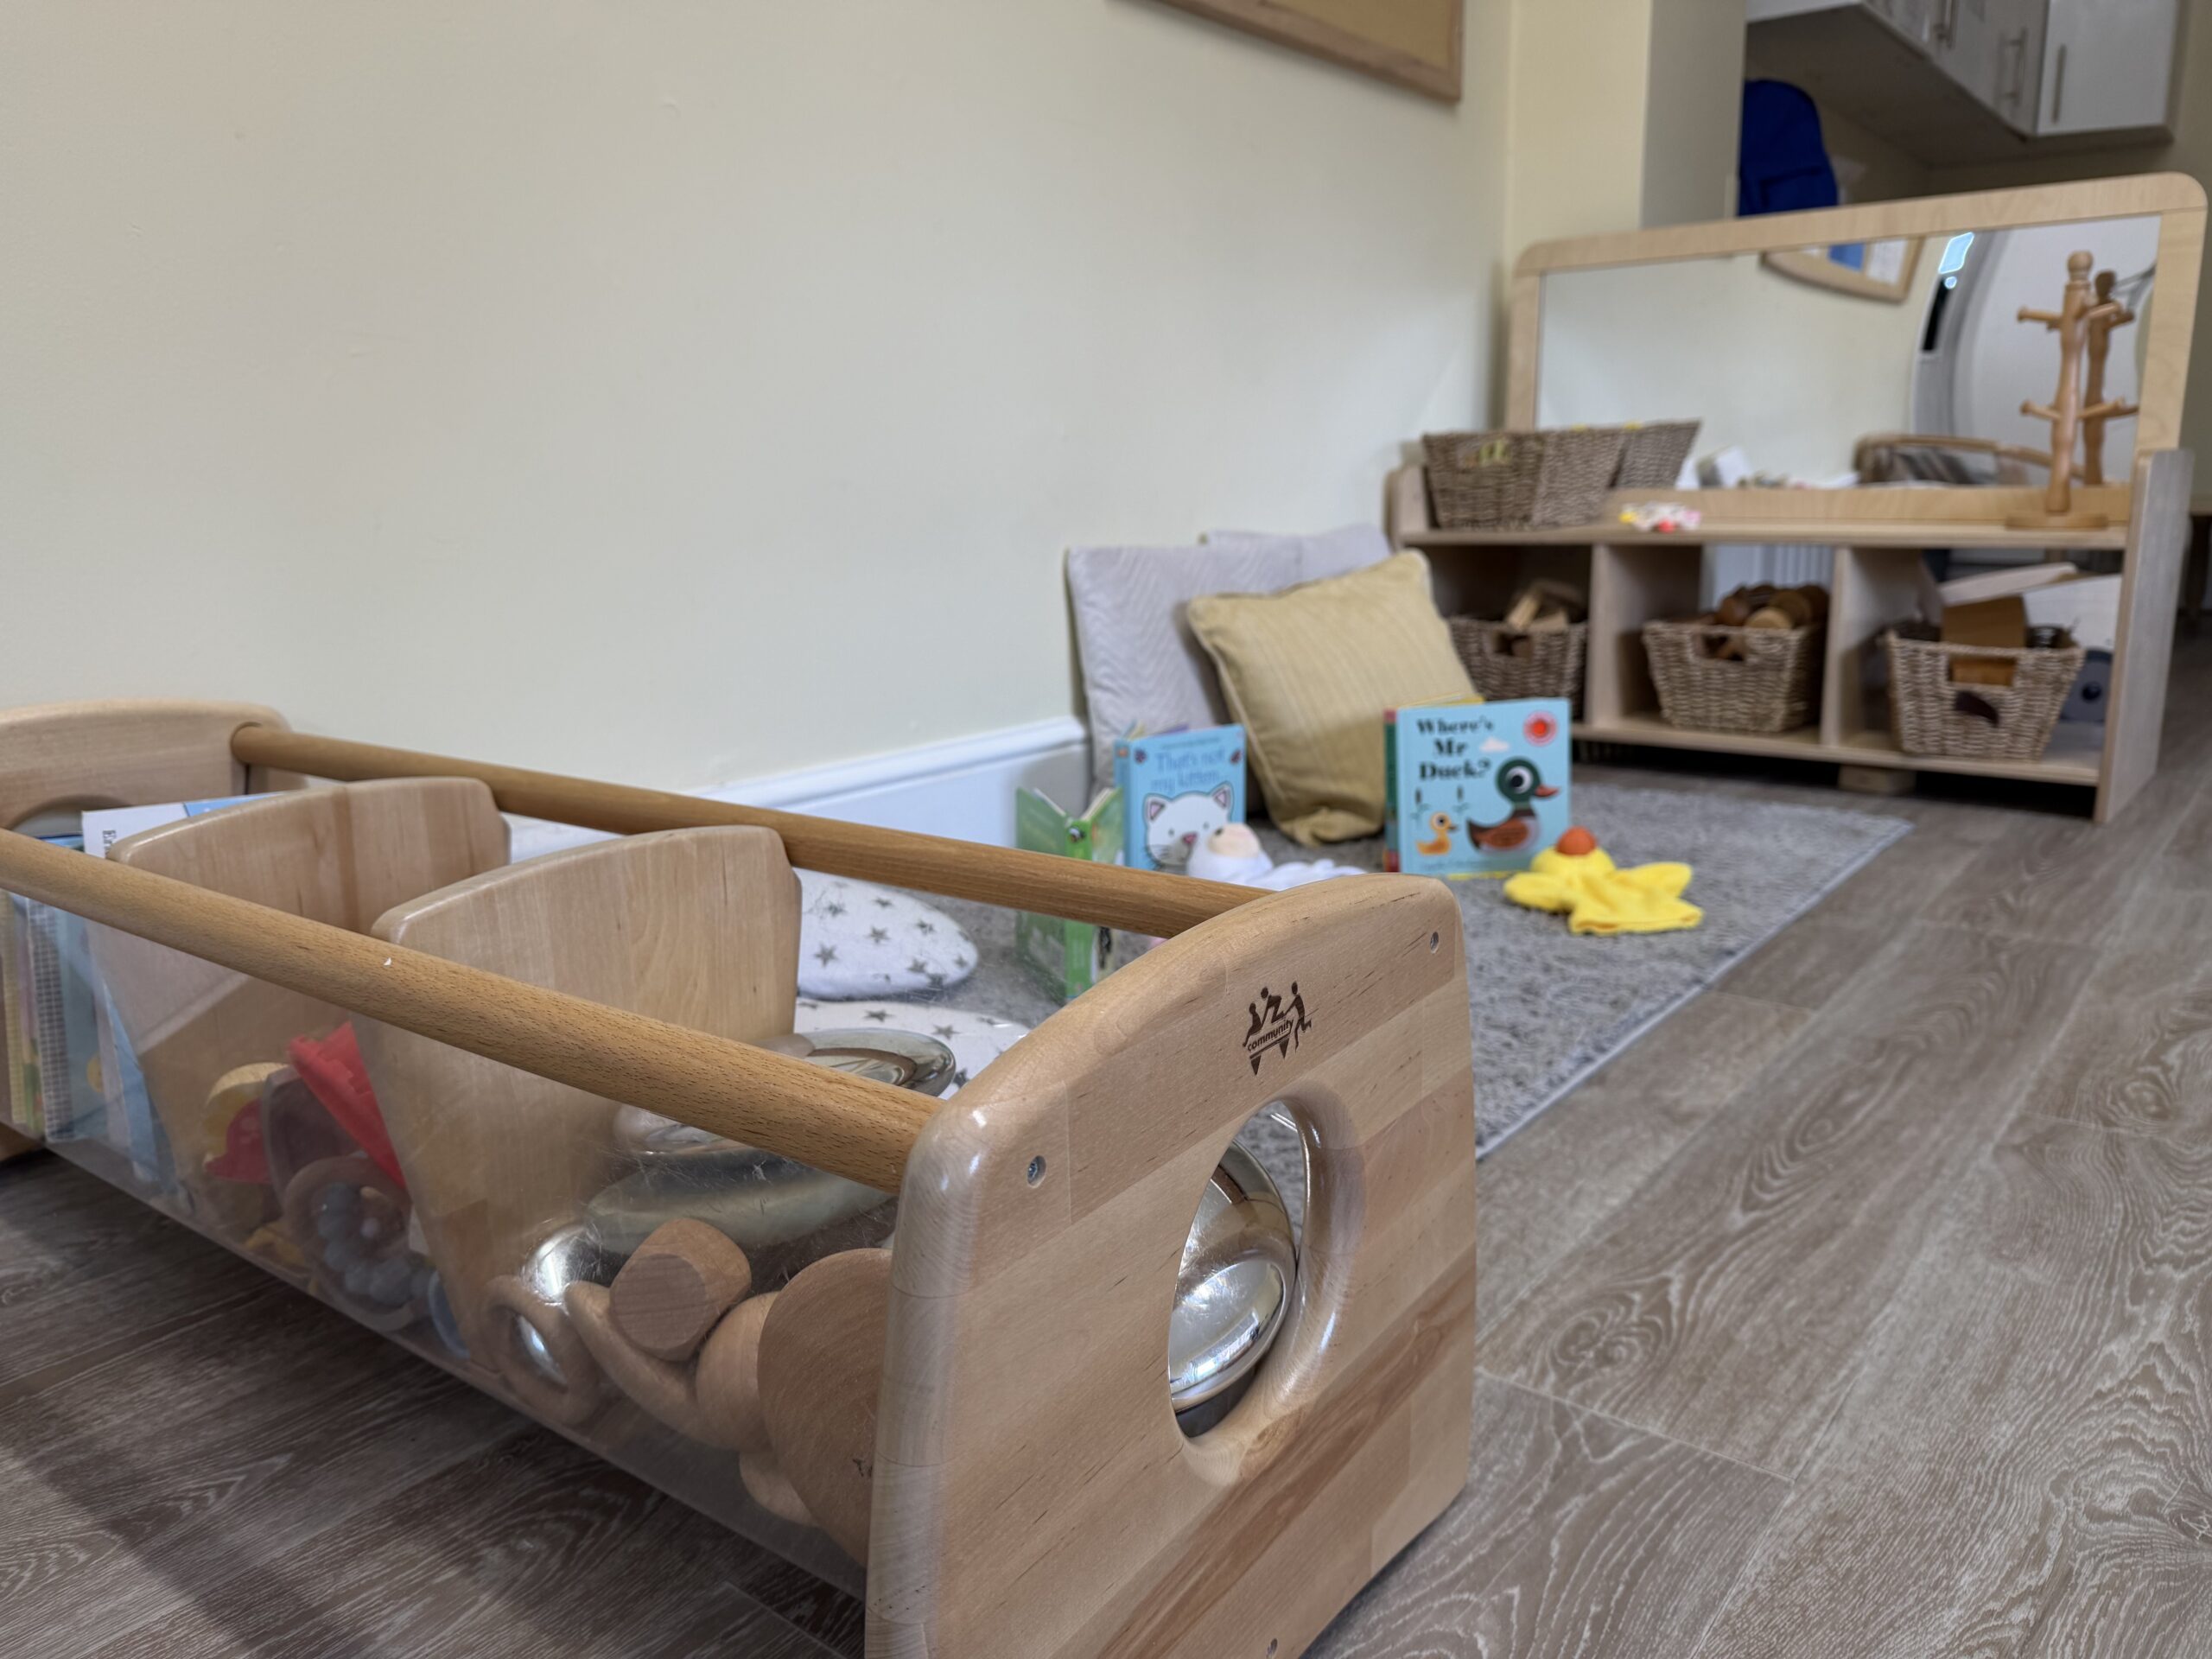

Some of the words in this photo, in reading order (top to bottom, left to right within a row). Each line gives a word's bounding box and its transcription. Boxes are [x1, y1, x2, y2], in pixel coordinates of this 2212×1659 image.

[1417, 717, 1493, 734] Where's
[1434, 738, 1467, 755] Mr
[1420, 759, 1491, 780] Duck?
